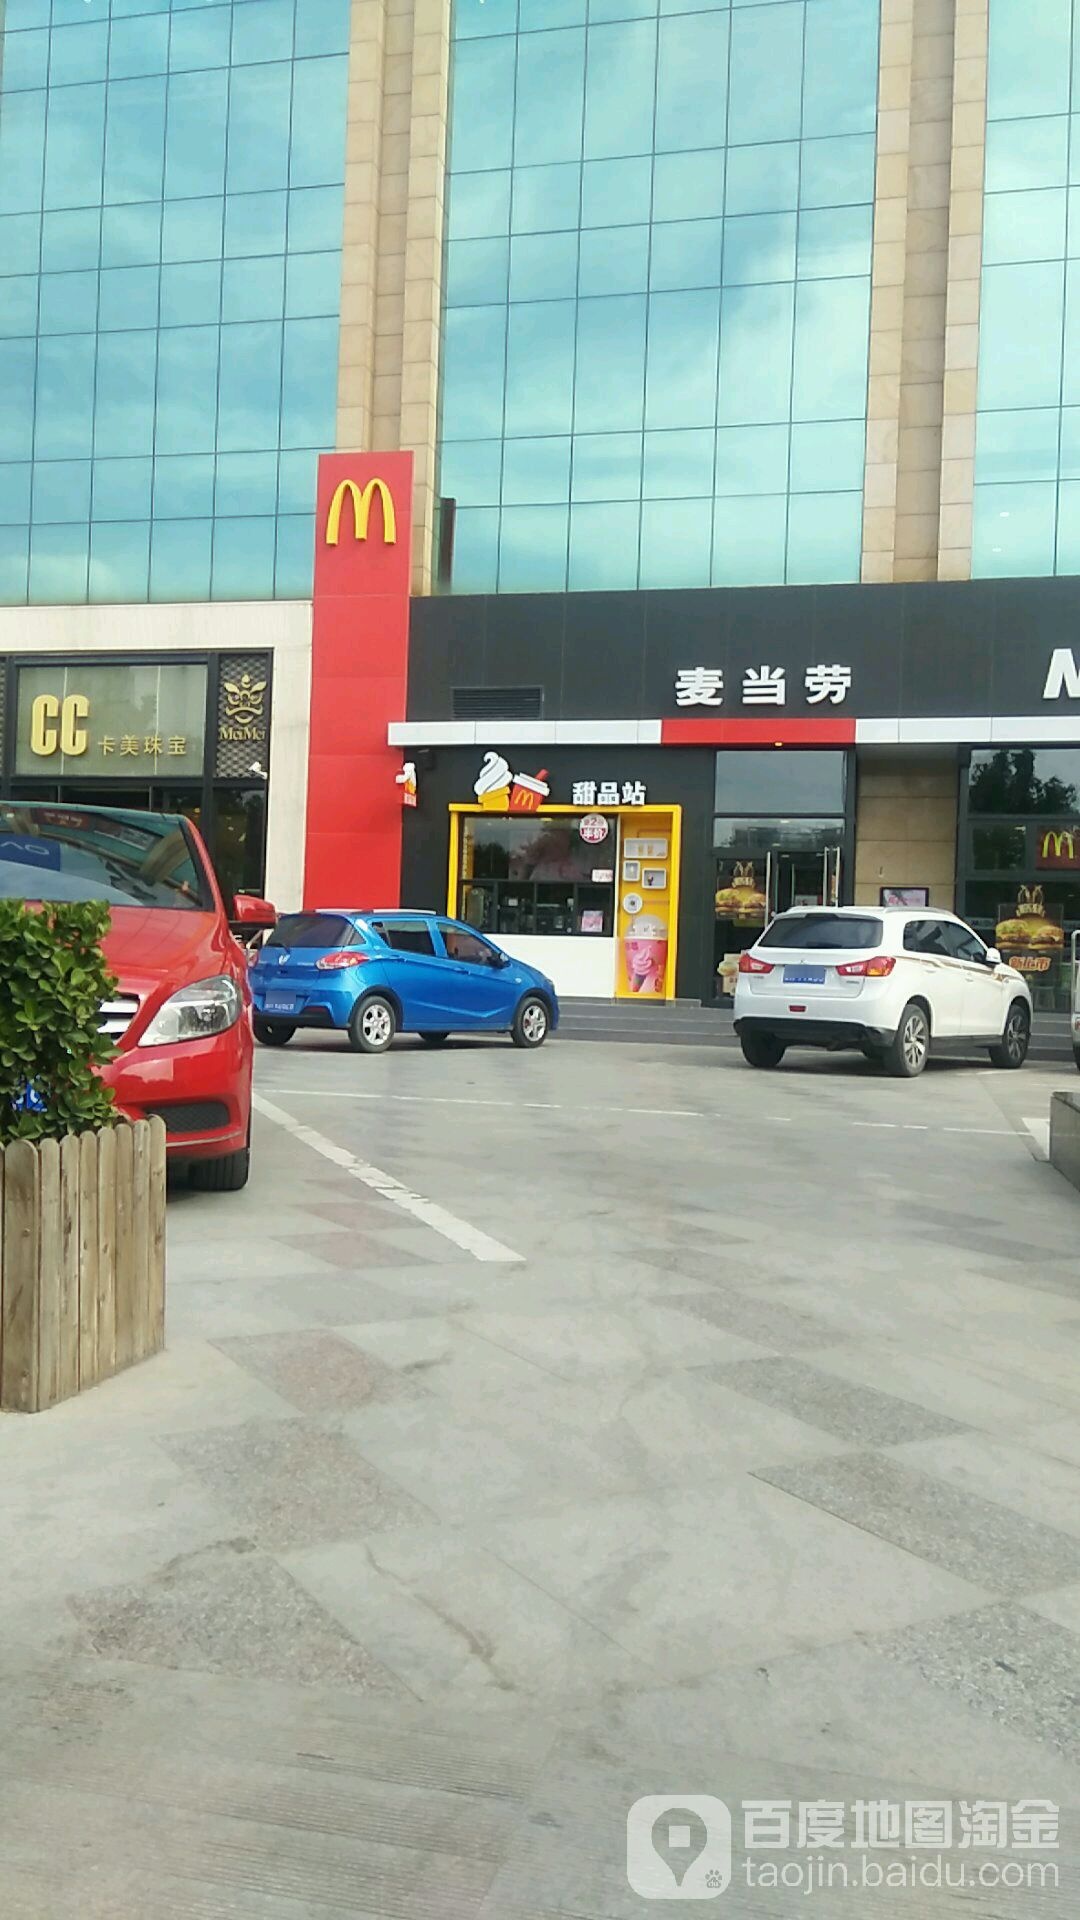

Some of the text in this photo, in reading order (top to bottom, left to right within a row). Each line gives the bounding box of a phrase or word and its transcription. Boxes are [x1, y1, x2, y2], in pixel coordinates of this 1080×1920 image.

[675, 664, 852, 706] 麦当劳
[30, 694, 90, 756] CC
[98, 734, 187, 757] 卡美珠宝
[572, 781, 647, 806] 甜品站
